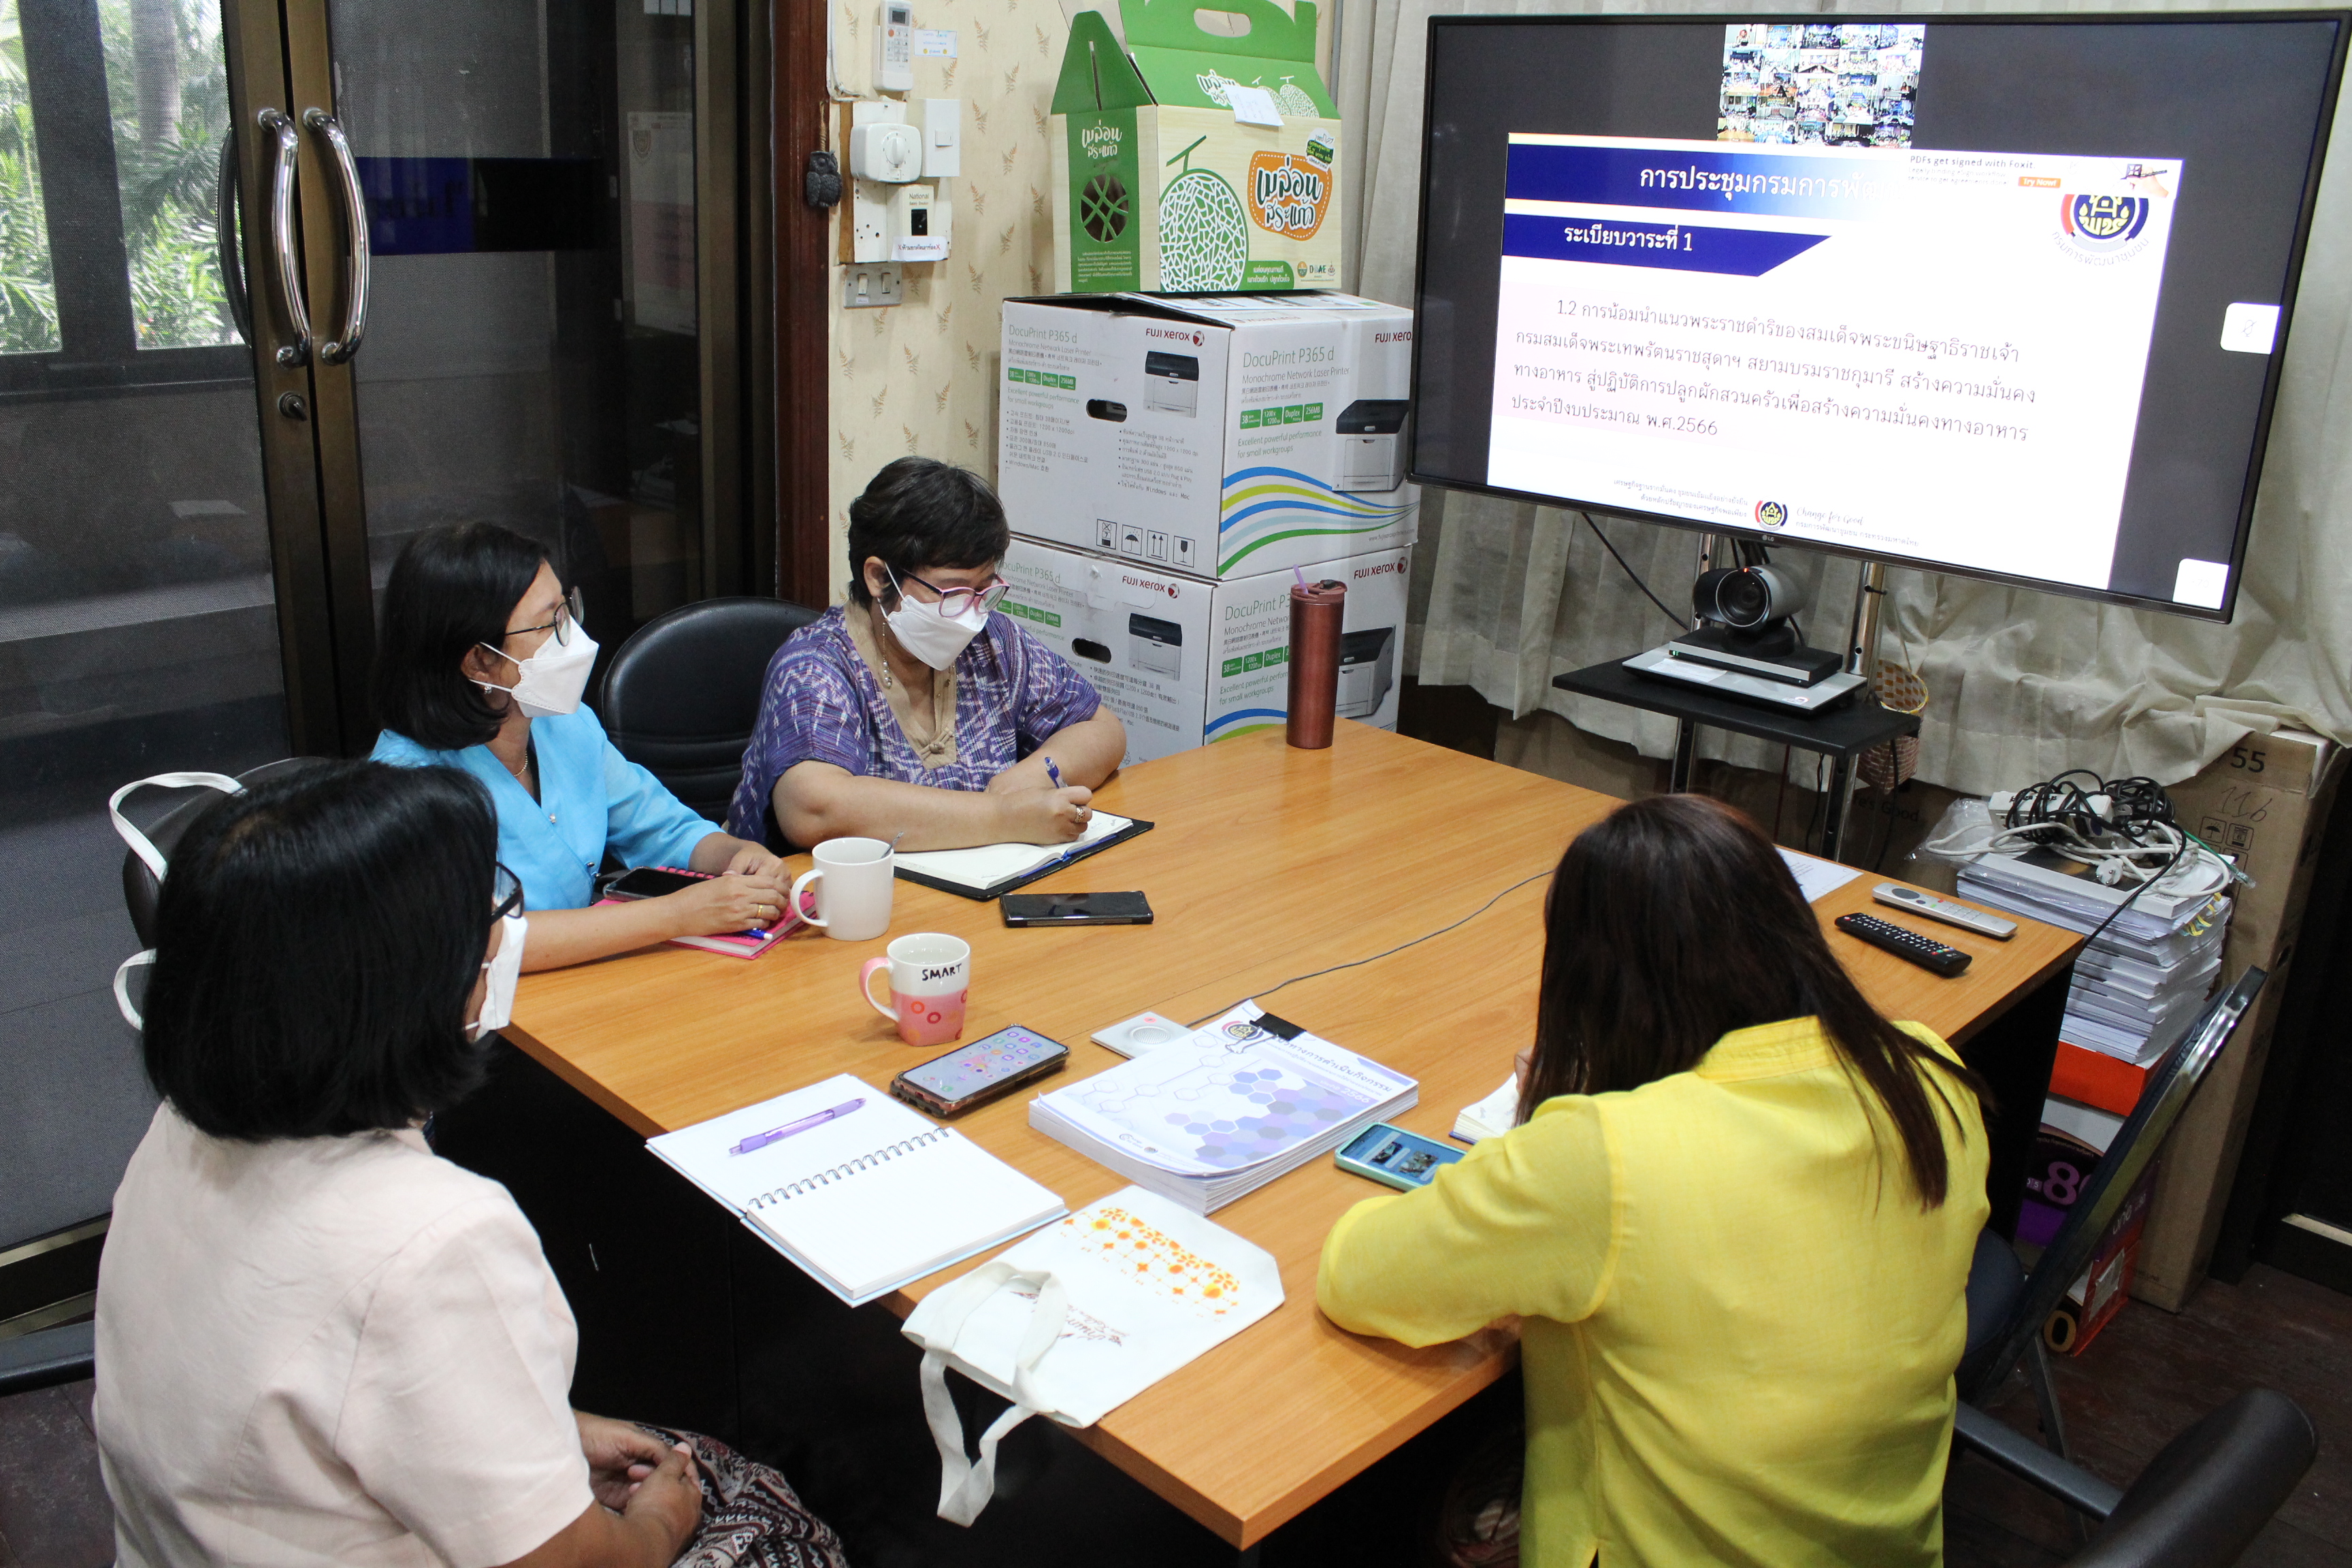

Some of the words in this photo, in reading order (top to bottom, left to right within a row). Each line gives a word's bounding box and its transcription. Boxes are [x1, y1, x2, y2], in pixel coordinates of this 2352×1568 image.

[1081, 119, 1123, 148] เมล่อน
[1910, 156, 1931, 165] PDFs
[1933, 158, 1948, 167] get
[1951, 158, 1982, 168] signed
[1985, 160, 2006, 168] with
[2009, 160, 2036, 169] Foxit.
[1256, 155, 1324, 206] เมล่อน
[2023, 178, 2034, 186] Try
[1264, 197, 1316, 231] สระแก้ว
[1564, 223, 1680, 250] ระเบียบวาระที่
[1683, 233, 1693, 252] 1
[2052, 231, 2149, 266] กรมการพัฒนาชุมชน
[1557, 299, 1577, 316] 1.2
[1009, 325, 1047, 340] DocuPrint
[1049, 329, 1070, 343] P365
[1072, 333, 1077, 344] d
[1145, 327, 1162, 338] FUJI
[1375, 333, 1391, 343] FUJI
[1009, 339, 1040, 349] Monochrome
[1040, 343, 1060, 352] Network
[1075, 348, 1092, 357] Printer
[1243, 350, 1296, 368] DocuPrint
[1298, 346, 1325, 363] P365
[1327, 345, 1335, 361] d
[1242, 373, 1286, 385] Monochrome
[1287, 369, 1313, 380] Network
[1313, 368, 1330, 378] Laser
[1330, 366, 1350, 376] Printer
[1514, 363, 1581, 384] ทางอาหาร
[1516, 331, 1741, 370] กรมสมเด็จพระเทพรัตนราชสุดาฯ
[1748, 357, 1894, 389] สยามบรมราชกุมารี
[1900, 370, 2036, 404] สร้างความมั่นคง
[1007, 387, 1028, 396] Excellent
[1049, 394, 1079, 404] performance
[1027, 400, 1054, 410] workgroups
[1241, 415, 1248, 424] 38
[1285, 409, 1301, 419] Duplex
[1305, 406, 1320, 415] 256MB
[1512, 395, 1640, 425] ประจำปีงบประมาณ
[1646, 415, 1718, 436] พ.ศ.2566
[1238, 436, 1262, 447] Excellent
[1264, 434, 1288, 445] powerful
[1288, 429, 1322, 442] performance
[1237, 449, 1245, 459] for
[1246, 448, 1262, 458] small
[1262, 444, 1293, 457] workgroups
[1797, 506, 1827, 521] Change
[1829, 510, 1841, 524] for
[1843, 514, 1865, 526] Good
[1034, 567, 1054, 581] P365
[1055, 574, 1061, 583] d
[1122, 575, 1138, 586] FUJI
[1354, 568, 1369, 580] FUJI
[1026, 579, 1046, 590] Network
[1225, 598, 1276, 621] DocuPrint
[1224, 620, 1267, 636] Monochrome
[1223, 664, 1230, 673] 38
[1265, 652, 1281, 662] Duplex
[1220, 682, 1245, 694] Excellent
[1245, 675, 1269, 689] powerful
[1219, 697, 1228, 706] for
[1228, 693, 1243, 703] small
[1244, 686, 1275, 700] workgroups
[2230, 747, 2266, 772] 55
[921, 963, 962, 981] SMART
[1340, 1088, 1371, 1104] 2566
